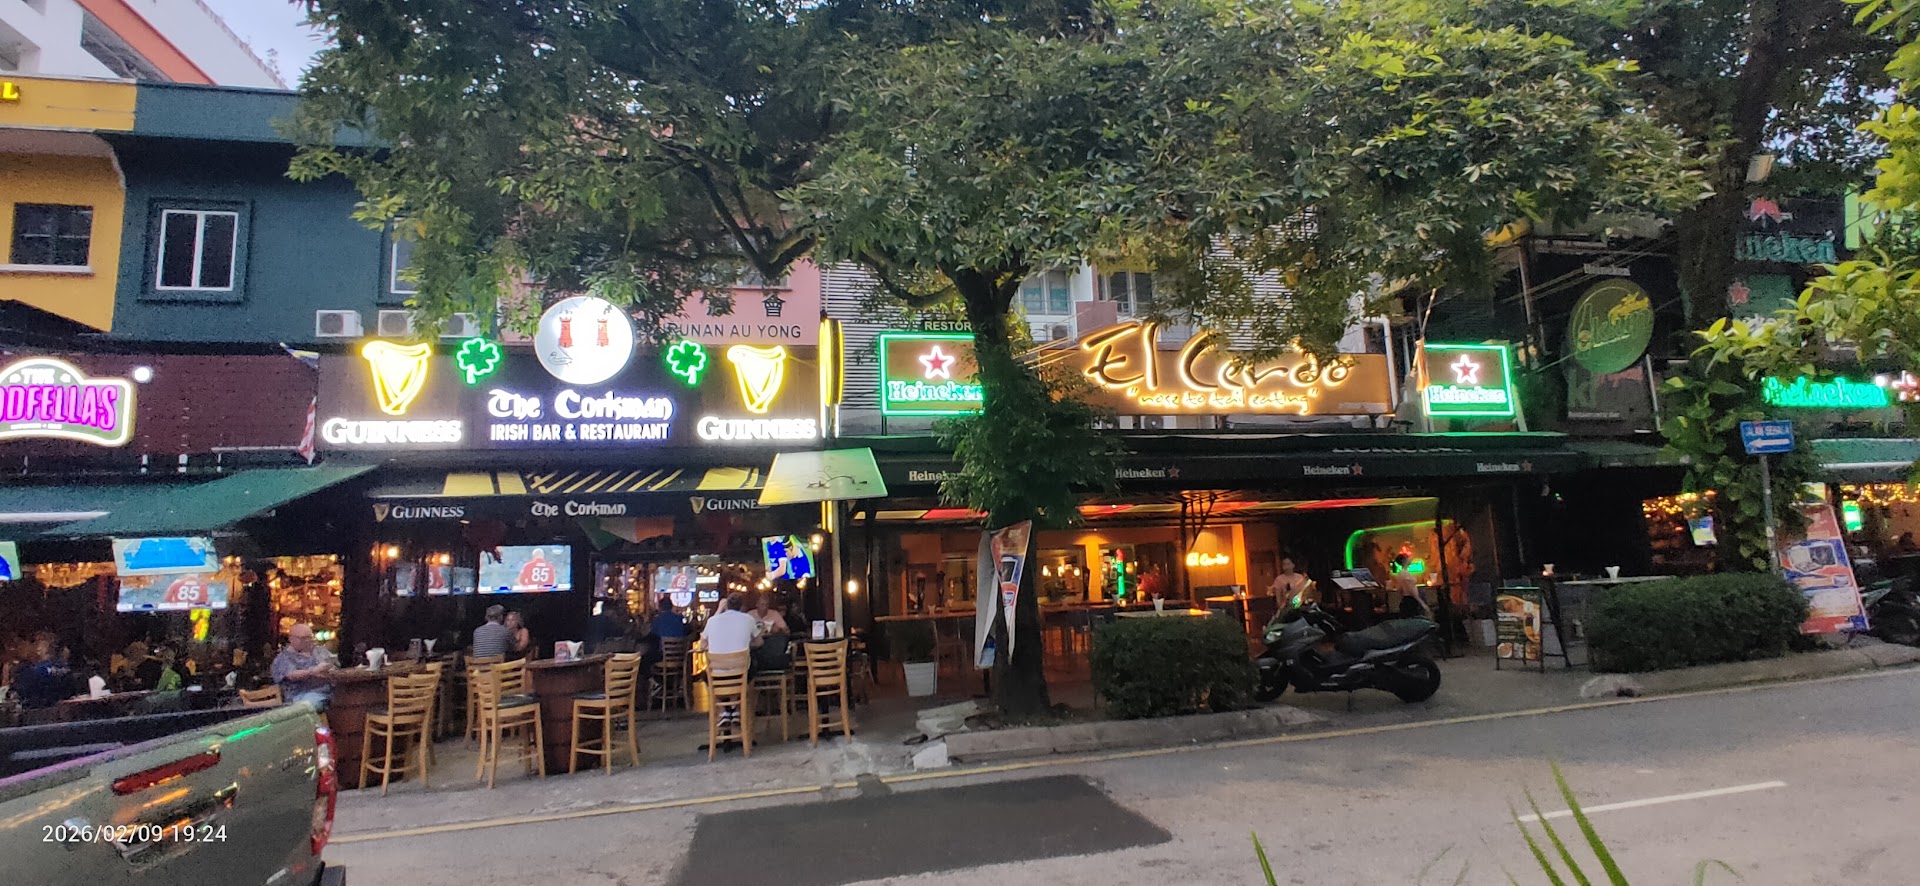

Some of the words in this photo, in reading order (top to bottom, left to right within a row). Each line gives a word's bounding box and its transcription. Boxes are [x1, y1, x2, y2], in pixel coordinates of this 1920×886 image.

[3, 82, 18, 99] L
[1735, 230, 1838, 264] ineken
[730, 324, 751, 338] AU
[757, 324, 801, 339] YONG
[1082, 321, 1158, 390] El
[1179, 329, 1357, 391] Cerdo
[1214, 388, 1245, 406] tail
[1428, 385, 1506, 403] Heineken
[0, 385, 118, 431] DFELLAS
[488, 388, 544, 420] The
[554, 389, 674, 420] Corkman
[322, 417, 462, 444] GUINNESS
[490, 423, 529, 441] IRISH
[532, 424, 561, 440] BAR
[565, 424, 577, 440] &
[580, 423, 670, 440] RESTAURANT
[697, 416, 817, 441] GUINNESS
[1115, 467, 1165, 479] Heineken
[1302, 465, 1350, 475] Heineken
[1476, 461, 1519, 472] Heineken
[909, 470, 962, 481] Heinek
[391, 505, 465, 519] GUINNESS
[531, 500, 558, 517] The
[565, 500, 626, 516] Corkman
[706, 498, 764, 511] GUINNE
[530, 567, 550, 582] 85
[177, 585, 200, 601] 85
